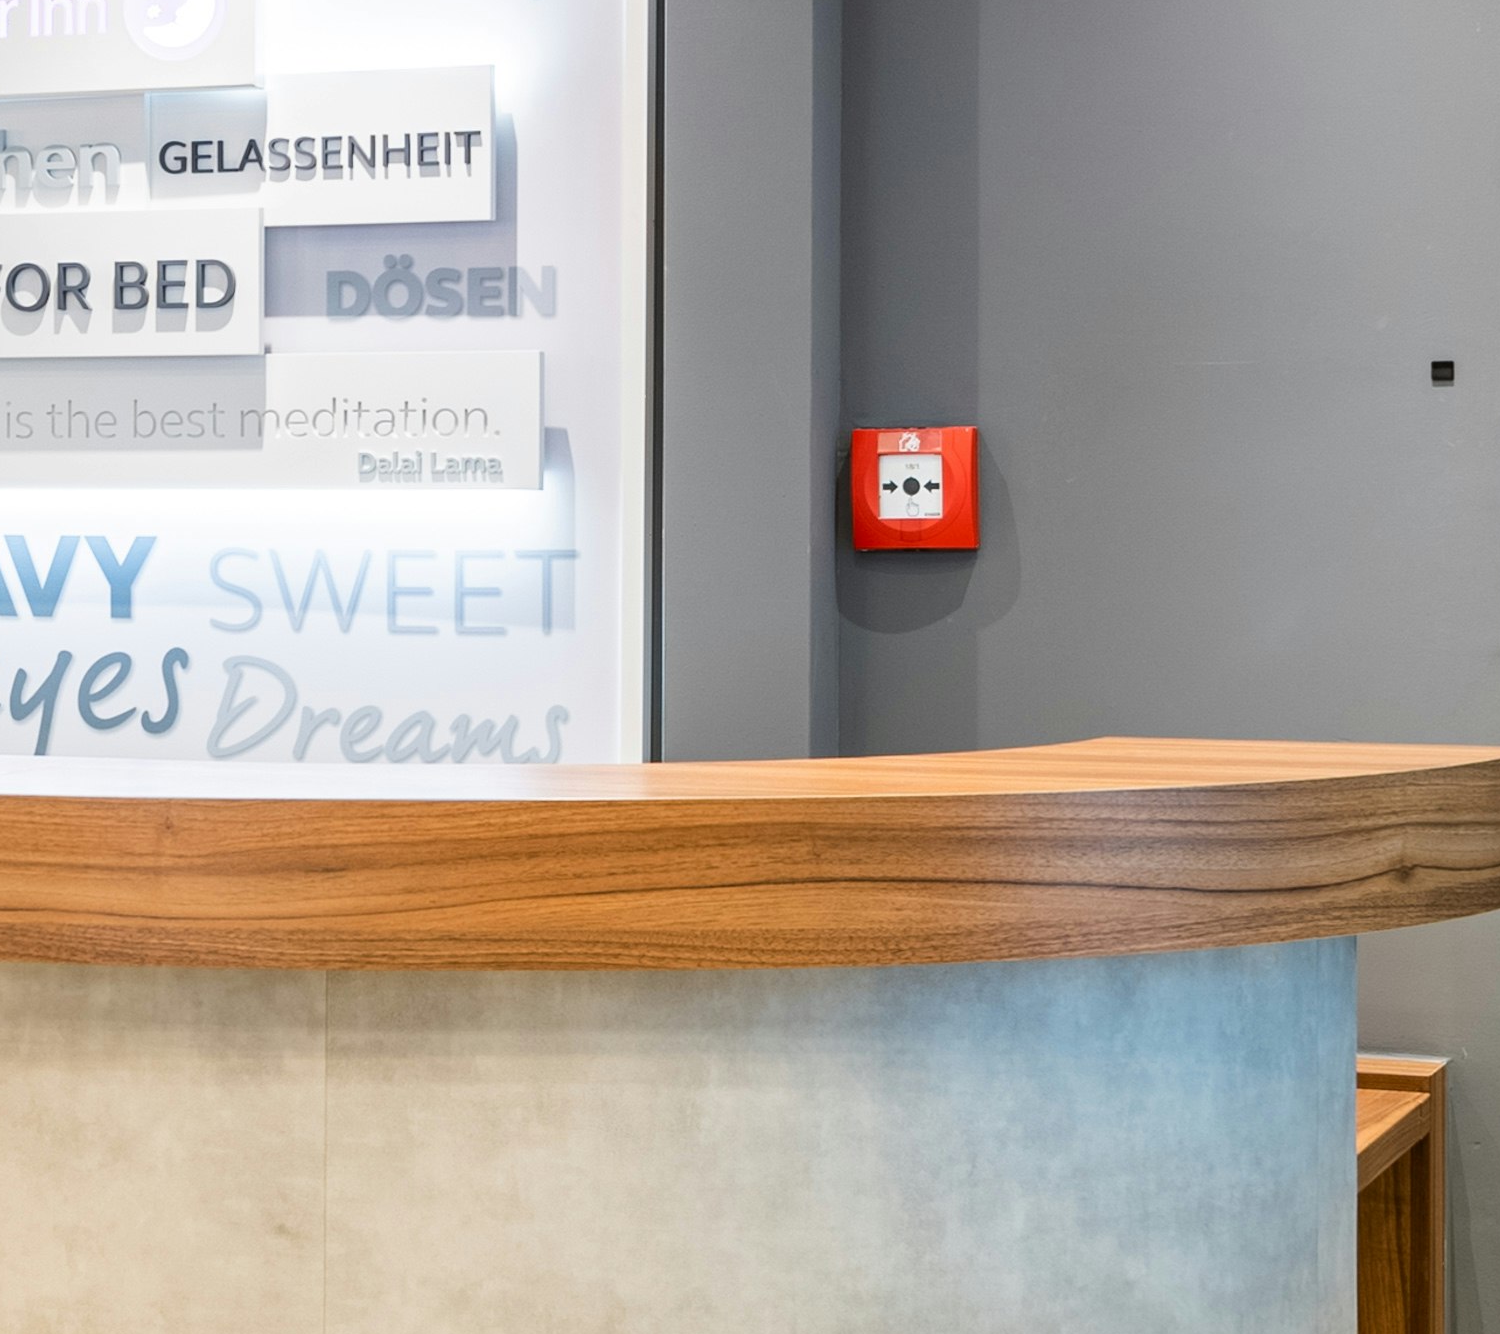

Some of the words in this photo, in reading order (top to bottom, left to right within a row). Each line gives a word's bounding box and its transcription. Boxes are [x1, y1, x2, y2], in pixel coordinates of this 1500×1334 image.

[158, 130, 482, 175] GELASSENHEIT
[116, 258, 237, 312] BED
[324, 253, 558, 322] DÖSEN
[3, 400, 34, 440] is
[45, 398, 117, 440] the
[131, 397, 228, 440] best
[242, 397, 502, 440] meditation.
[358, 450, 423, 475] Dalai
[430, 452, 504, 475] Lama
[207, 547, 581, 637] SWEET
[205, 654, 571, 765] Dreams
